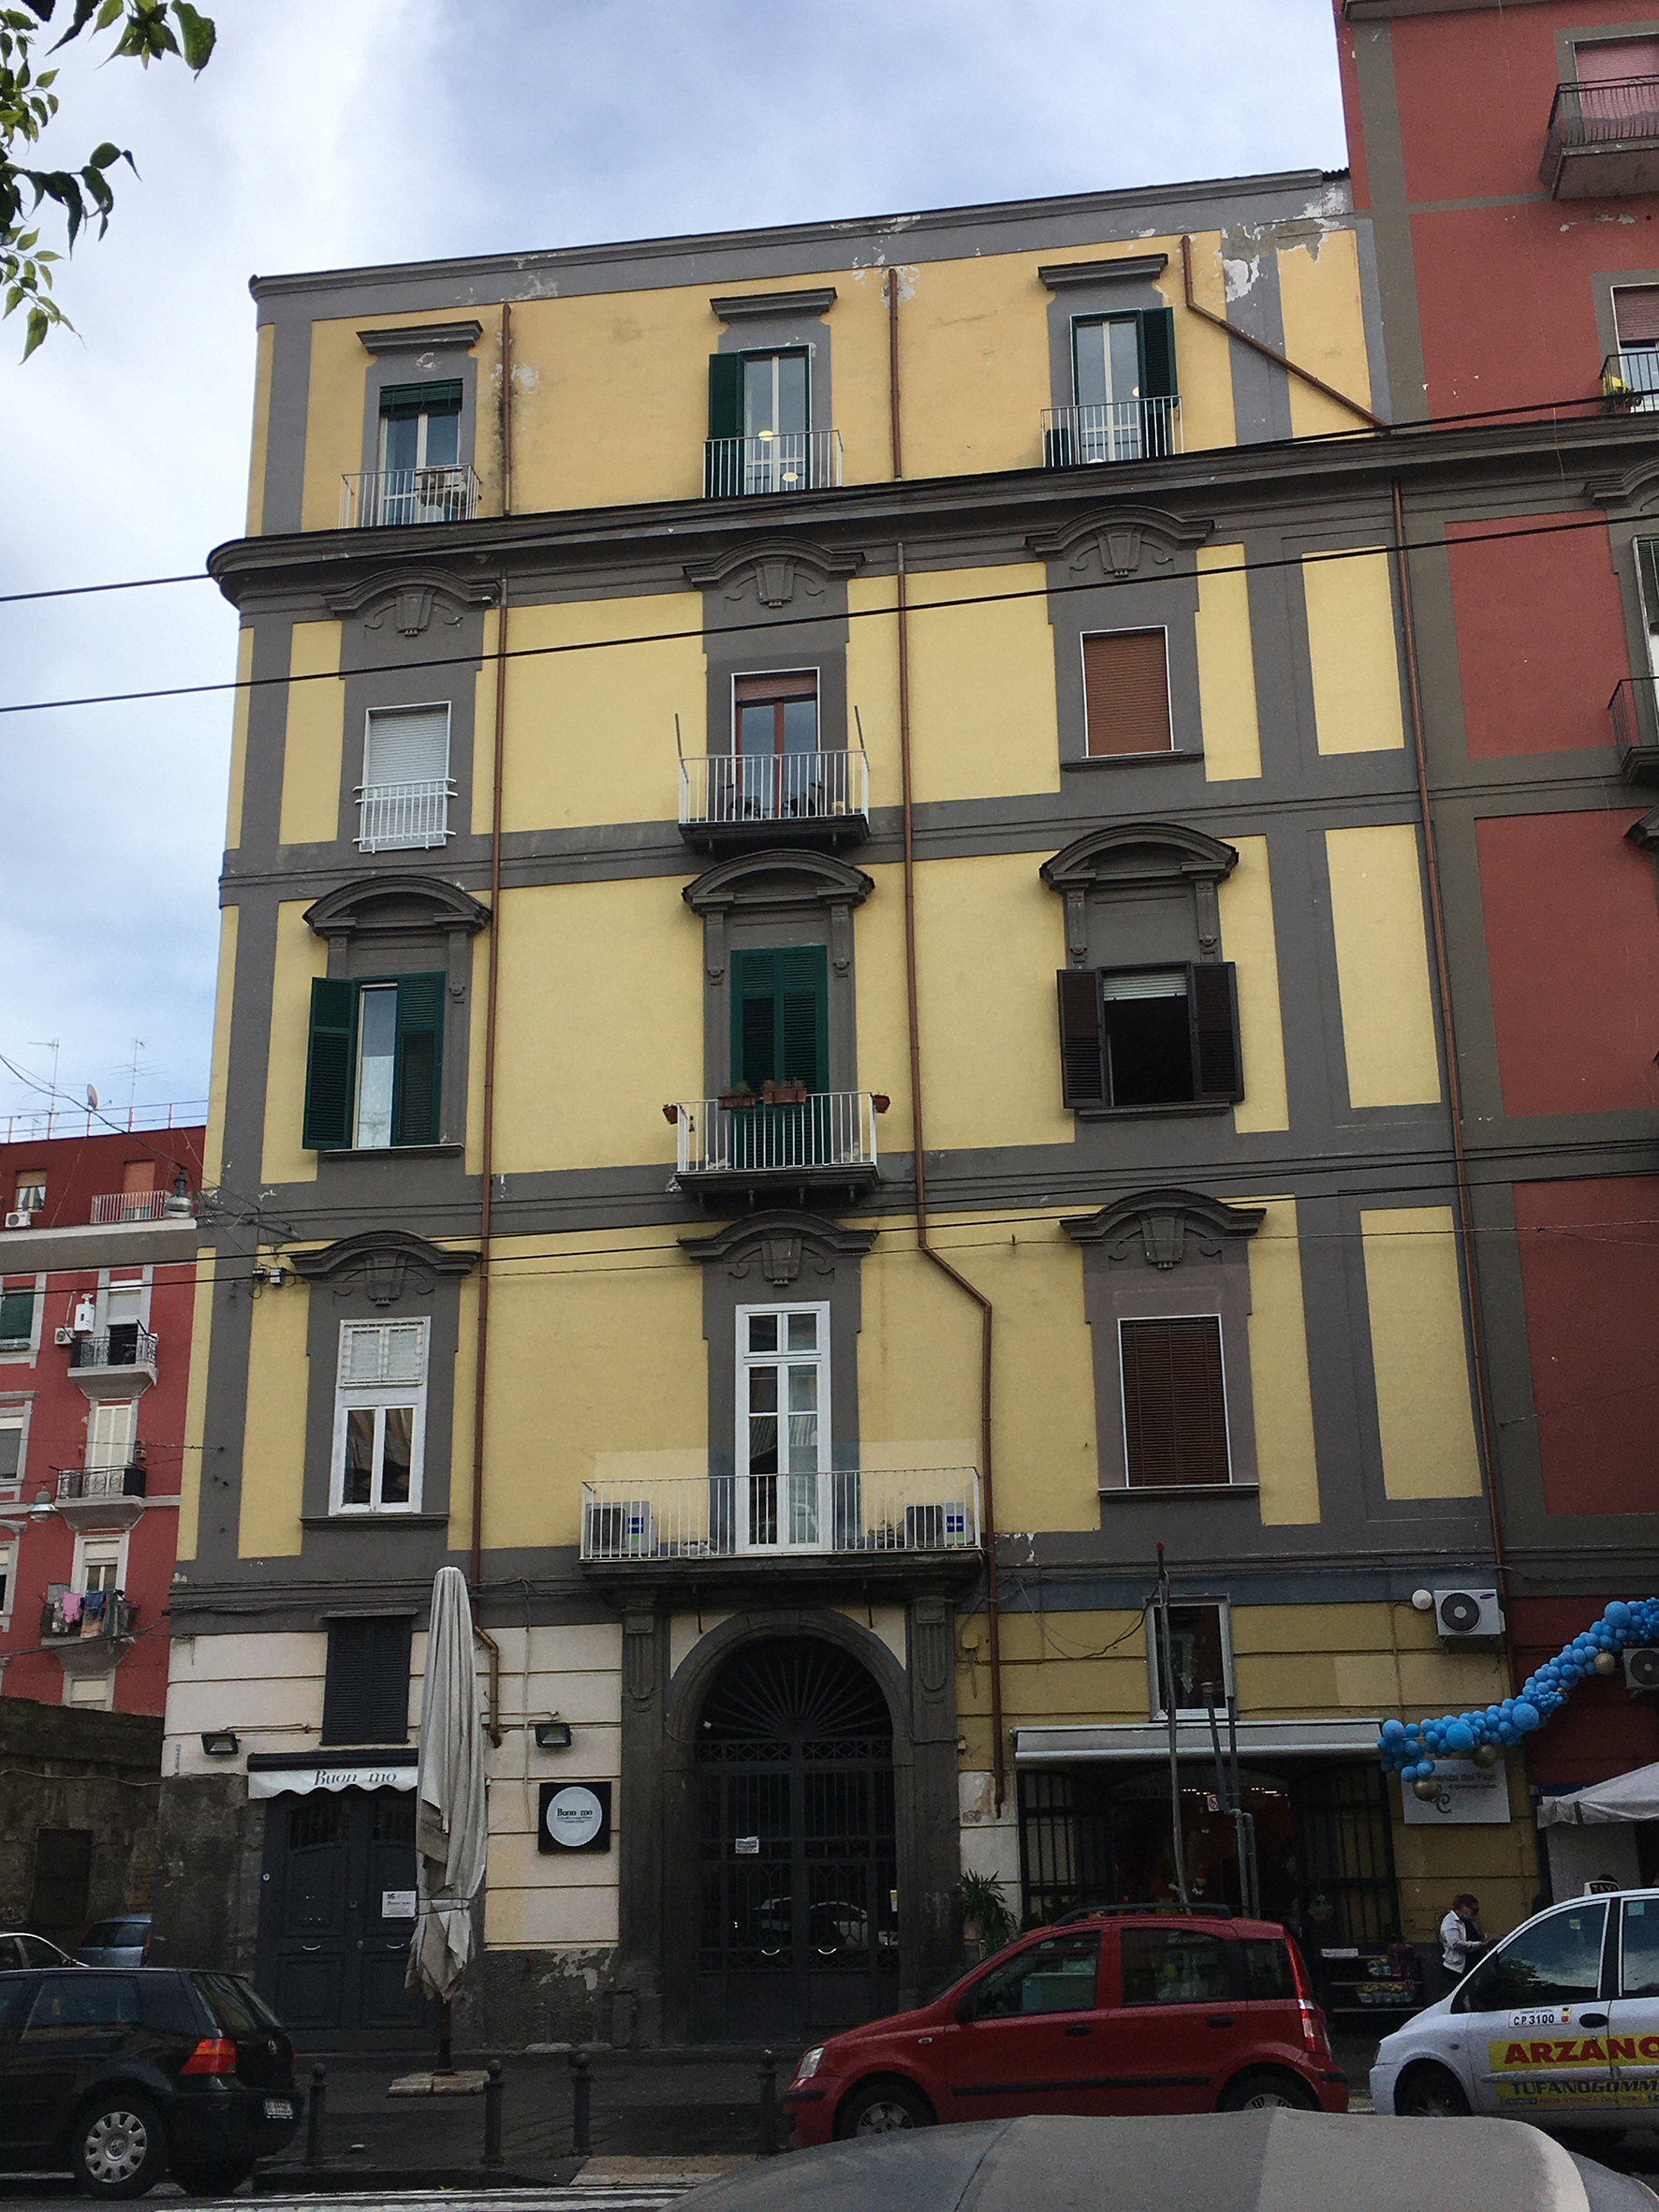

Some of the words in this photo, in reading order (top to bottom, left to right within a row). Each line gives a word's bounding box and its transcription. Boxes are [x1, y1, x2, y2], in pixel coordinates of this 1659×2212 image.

[315, 1770, 357, 1785] Buon
[1528, 2013, 1555, 2025] 3100
[1505, 2037, 1659, 2064] ARZANO
[1511, 2080, 1659, 2095] TUFANOGOMM
